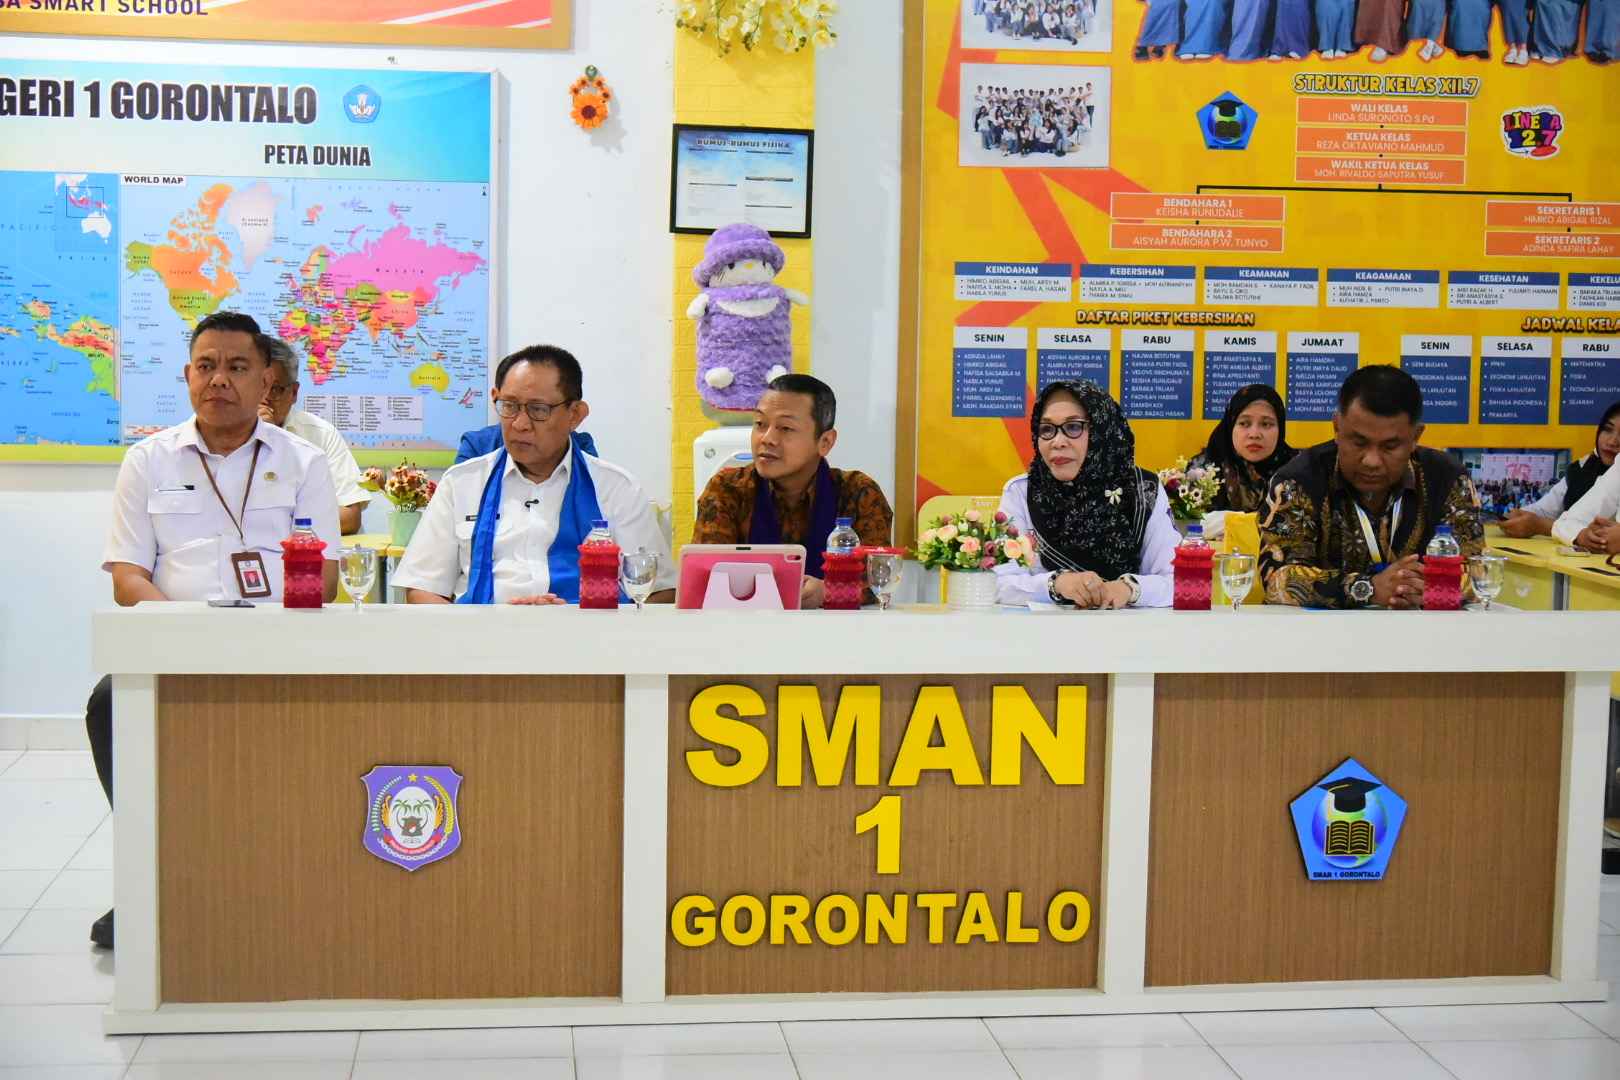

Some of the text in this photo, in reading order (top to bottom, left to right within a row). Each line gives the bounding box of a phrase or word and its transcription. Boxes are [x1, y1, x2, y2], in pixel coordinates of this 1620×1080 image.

[117, 0, 208, 15] SCHOOL
[1294, 74, 1382, 93] STRUKTUR
[1384, 76, 1436, 94] KELAS
[84, 80, 100, 118] 1
[110, 81, 317, 124] GORONTALO
[1350, 104, 1408, 113] WALI KELAS
[1328, 112, 1354, 122] LINDA
[1346, 132, 1410, 142] KETUA KELAS
[1316, 141, 1340, 150] REZA
[1400, 144, 1445, 152] MAHMUD
[264, 144, 371, 166] PETA DUNIA
[1331, 160, 1429, 170] WAKIL KETUA KELAS
[124, 176, 160, 184] WORLD
[1164, 198, 1226, 208] BENDAHARA
[1156, 207, 1190, 216] KEISHA
[1536, 206, 1595, 215] SEKRETARIS
[1162, 228, 1233, 238] BENDAHARA 2
[1171, 238, 1210, 247] AURORA
[1535, 236, 1592, 244] SEKRETARIS
[986, 266, 1038, 274] KEINDAHAN
[1110, 267, 1164, 276] KEBERSIHAN
[1239, 270, 1289, 278] KEAMANAN
[1355, 272, 1411, 280] KEAGAMAAN
[1479, 274, 1528, 283] KESEHATAN
[1076, 310, 1256, 326] DAFTAR PIKET KEBERSIHAN
[1521, 316, 1585, 333] JADWAL
[974, 334, 1005, 342] SENIN
[1054, 334, 1092, 343] SELASA
[1143, 336, 1171, 344] RABU
[1224, 337, 1257, 346] KAMIS
[1301, 338, 1344, 347] JUMAAT
[1421, 342, 1450, 350] SENIN
[1497, 342, 1533, 351] SELASA
[1582, 344, 1609, 352] RABU
[684, 684, 1088, 788] SMAN
[854, 794, 902, 874] 1
[671, 891, 1091, 948] GORONTALO
